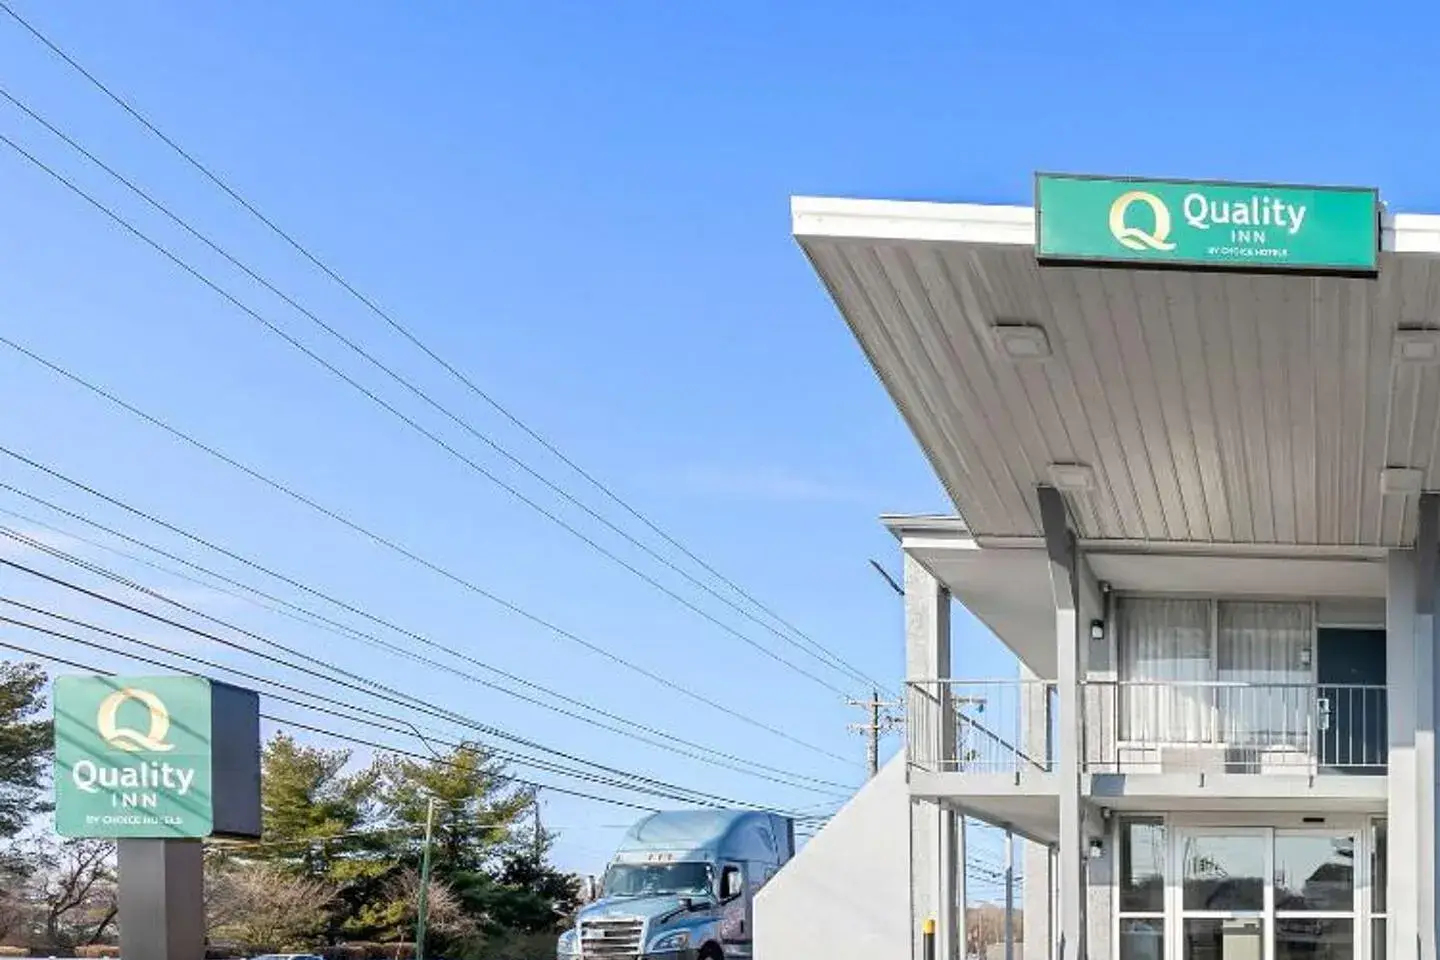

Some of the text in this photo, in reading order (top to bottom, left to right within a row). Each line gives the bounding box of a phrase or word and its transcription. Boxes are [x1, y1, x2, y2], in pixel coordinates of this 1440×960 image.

[1183, 192, 1307, 234] Quality
[1231, 229, 1266, 244] INN
[72, 759, 195, 795] Quality
[112, 792, 157, 808] INN
